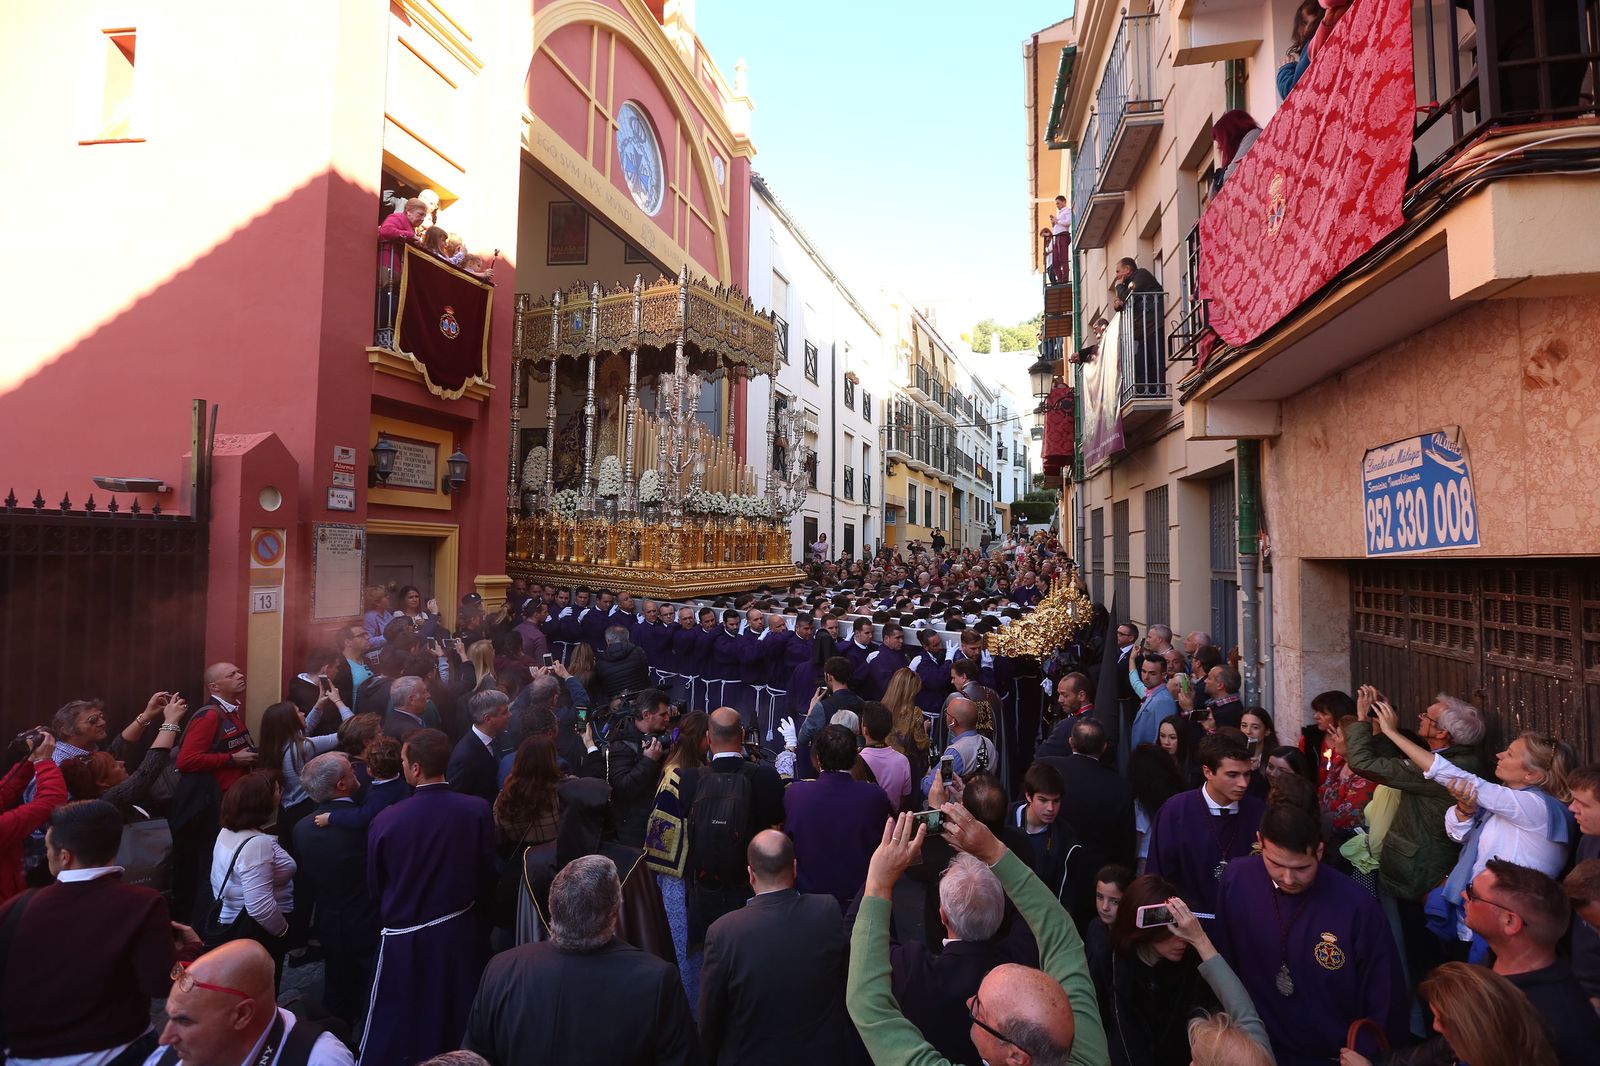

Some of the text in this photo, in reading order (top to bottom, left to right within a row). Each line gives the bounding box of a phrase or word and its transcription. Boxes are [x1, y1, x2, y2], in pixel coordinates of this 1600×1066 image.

[1366, 455, 1387, 474] Locales
[1387, 453, 1395, 467] de
[1366, 476, 1474, 552] 952 330 008
[259, 594, 272, 609] 13
